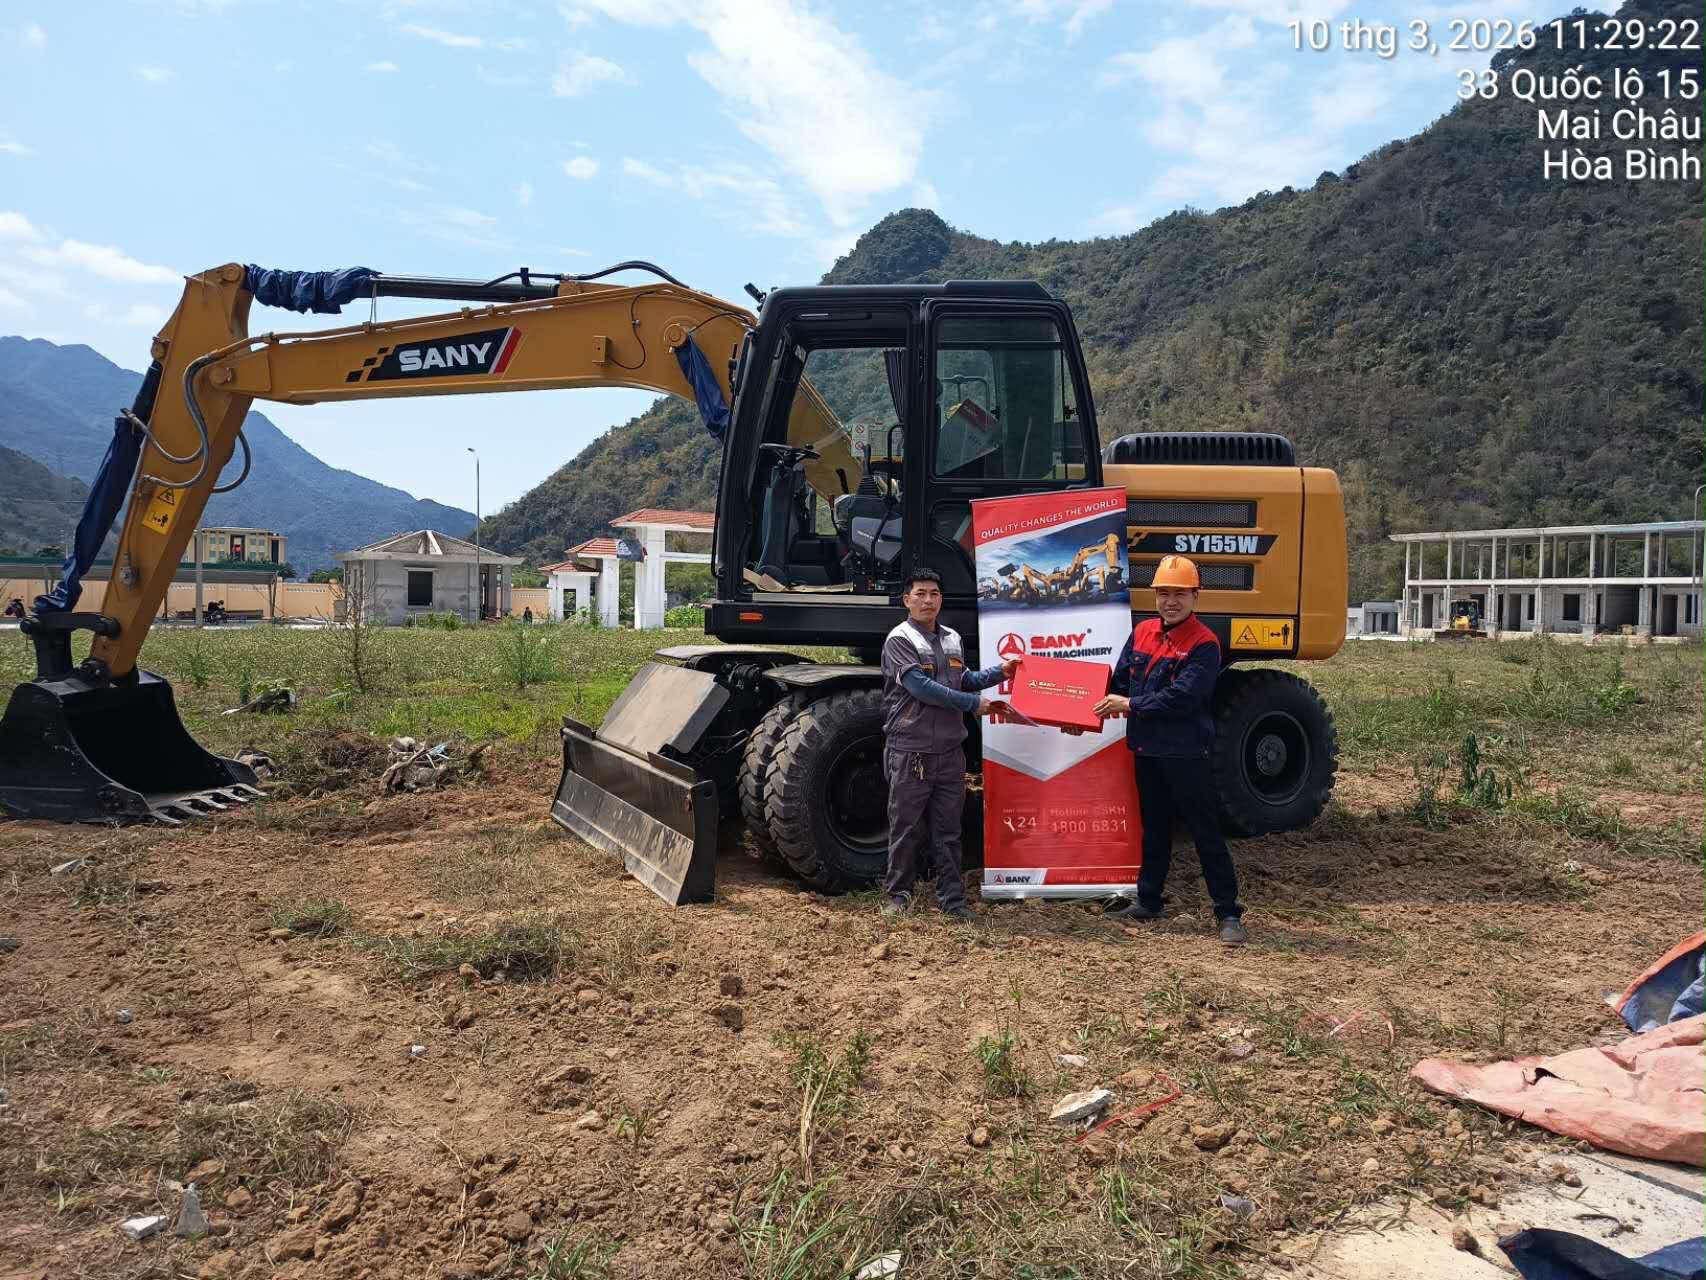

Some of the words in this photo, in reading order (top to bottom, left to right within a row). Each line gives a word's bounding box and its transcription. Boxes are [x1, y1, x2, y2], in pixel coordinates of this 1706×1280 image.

[399, 342, 492, 372] SANY
[981, 522, 1020, 539] QUALITY
[1020, 512, 1063, 529] CHANGES
[1065, 507, 1081, 518] THE
[1083, 498, 1118, 513] WORLD
[1175, 534, 1259, 554] SY155W
[1030, 633, 1086, 649] SANY
[1053, 646, 1113, 658] MACHINERY
[1052, 820, 1087, 833] 1800
[1092, 819, 1128, 833] 6831
[1005, 875, 1031, 883] SANY
